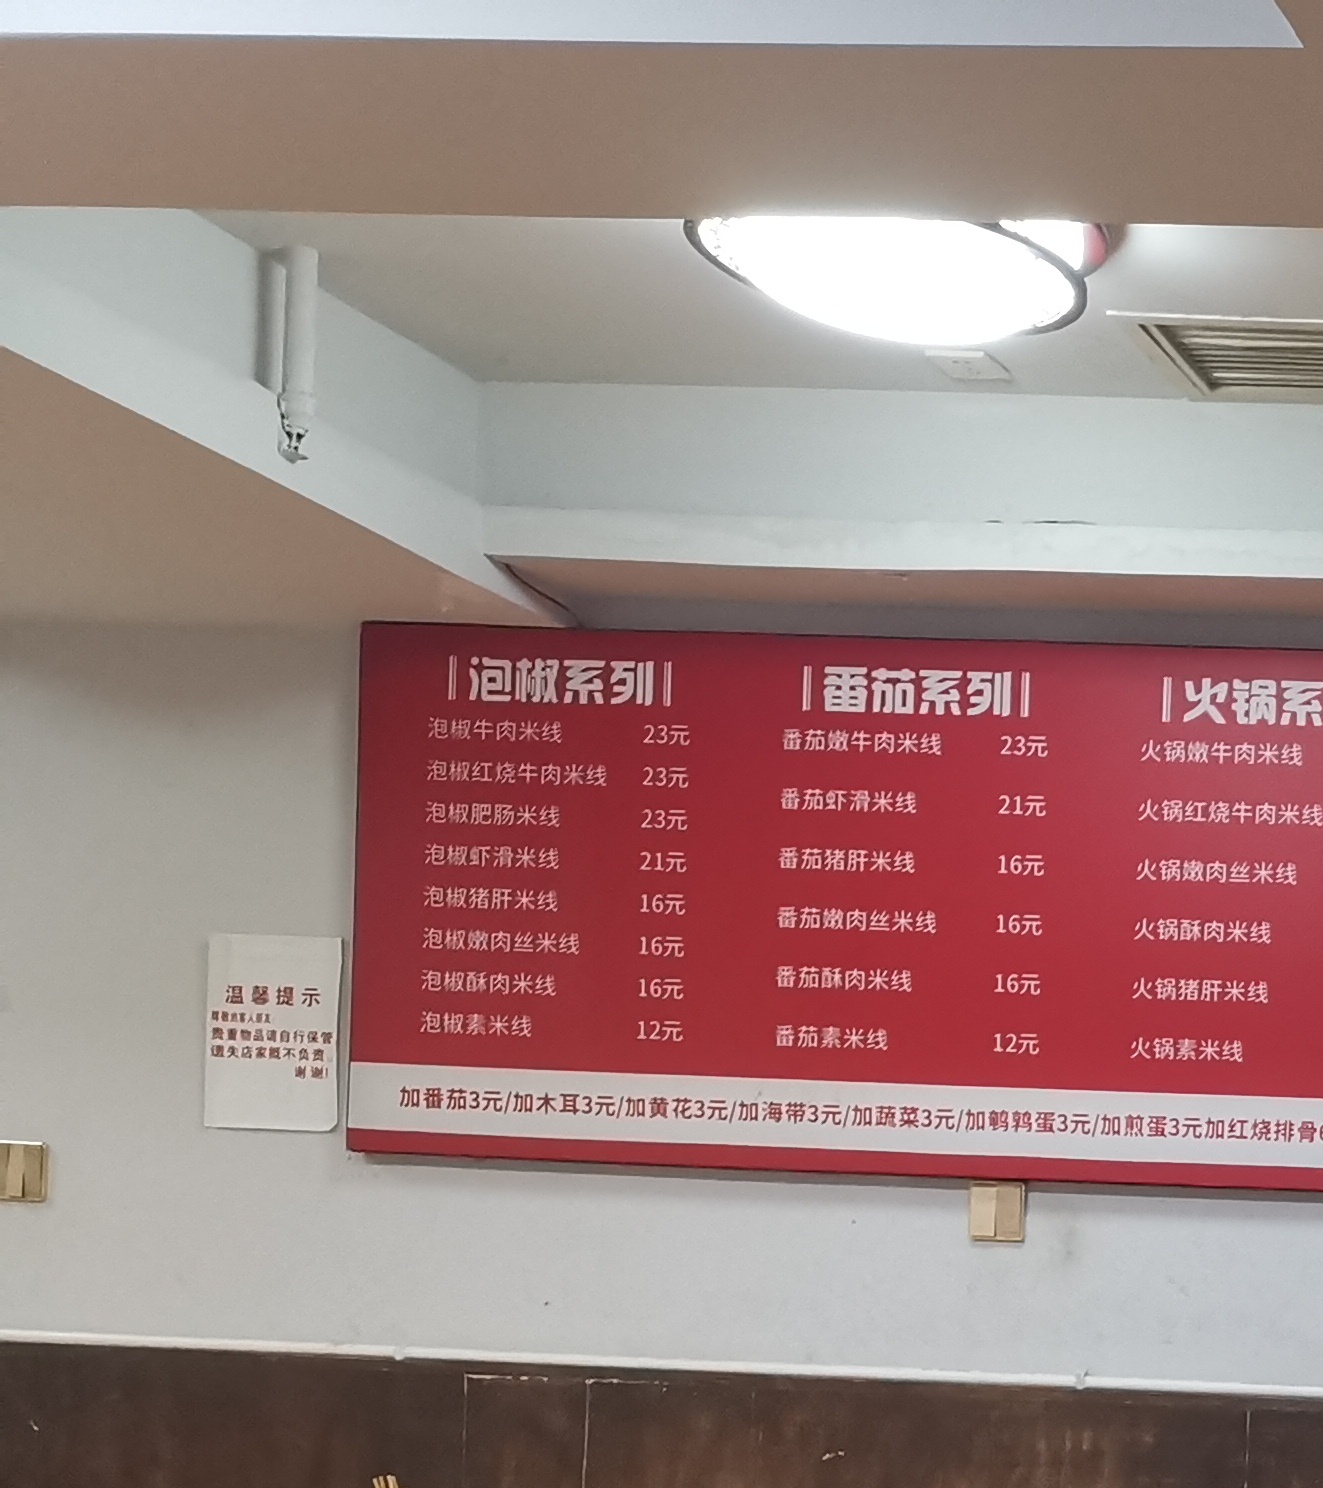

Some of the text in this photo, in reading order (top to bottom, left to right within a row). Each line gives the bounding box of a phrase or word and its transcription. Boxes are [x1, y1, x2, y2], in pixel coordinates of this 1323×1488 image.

[469, 655, 657, 706] 泡椒系列
[823, 666, 1015, 718] 番茄系列
[428, 717, 690, 745] 泡椒牛肉米线 23元
[783, 729, 1048, 757] 番茄嫩牛肉米线 23元
[1141, 740, 1305, 768] 火锅嫩牛肉米线
[427, 760, 688, 788] 泡椒红烧牛肉米线 23元
[425, 801, 688, 830] 泡椒肥肠米线 23元
[781, 788, 1046, 817] 番茄虾滑米线 21元
[1138, 799, 1323, 826] 火锅红烧牛肉米线
[425, 843, 687, 872] 泡椒虾滑米线 21元
[778, 847, 1044, 876] 番茄猪肝米线 16元
[1136, 858, 1299, 886] 火锅嫩肉丝米线
[423, 886, 686, 915] 泡椒猪肝米线 16元
[777, 906, 1042, 936] 番茄嫩肉丝米线 16元
[1134, 918, 1272, 944] 火锅酥肉米线
[422, 927, 684, 957] 泡椒嫩肉丝米线 16元
[421, 970, 684, 999] 泡椒酥肉米线 16元
[776, 966, 1040, 995] 番茄酥肉米线 16元
[1132, 977, 1268, 1003] 火锅猪肝米线
[225, 985, 321, 1007] 温馨提示
[211, 1027, 333, 1044] 贵重物品请自行保管
[420, 1011, 683, 1042] 泡椒素米线 12元
[776, 1025, 1039, 1055] 番茄素米线 12元
[1130, 1037, 1243, 1062] 火锅素米线
